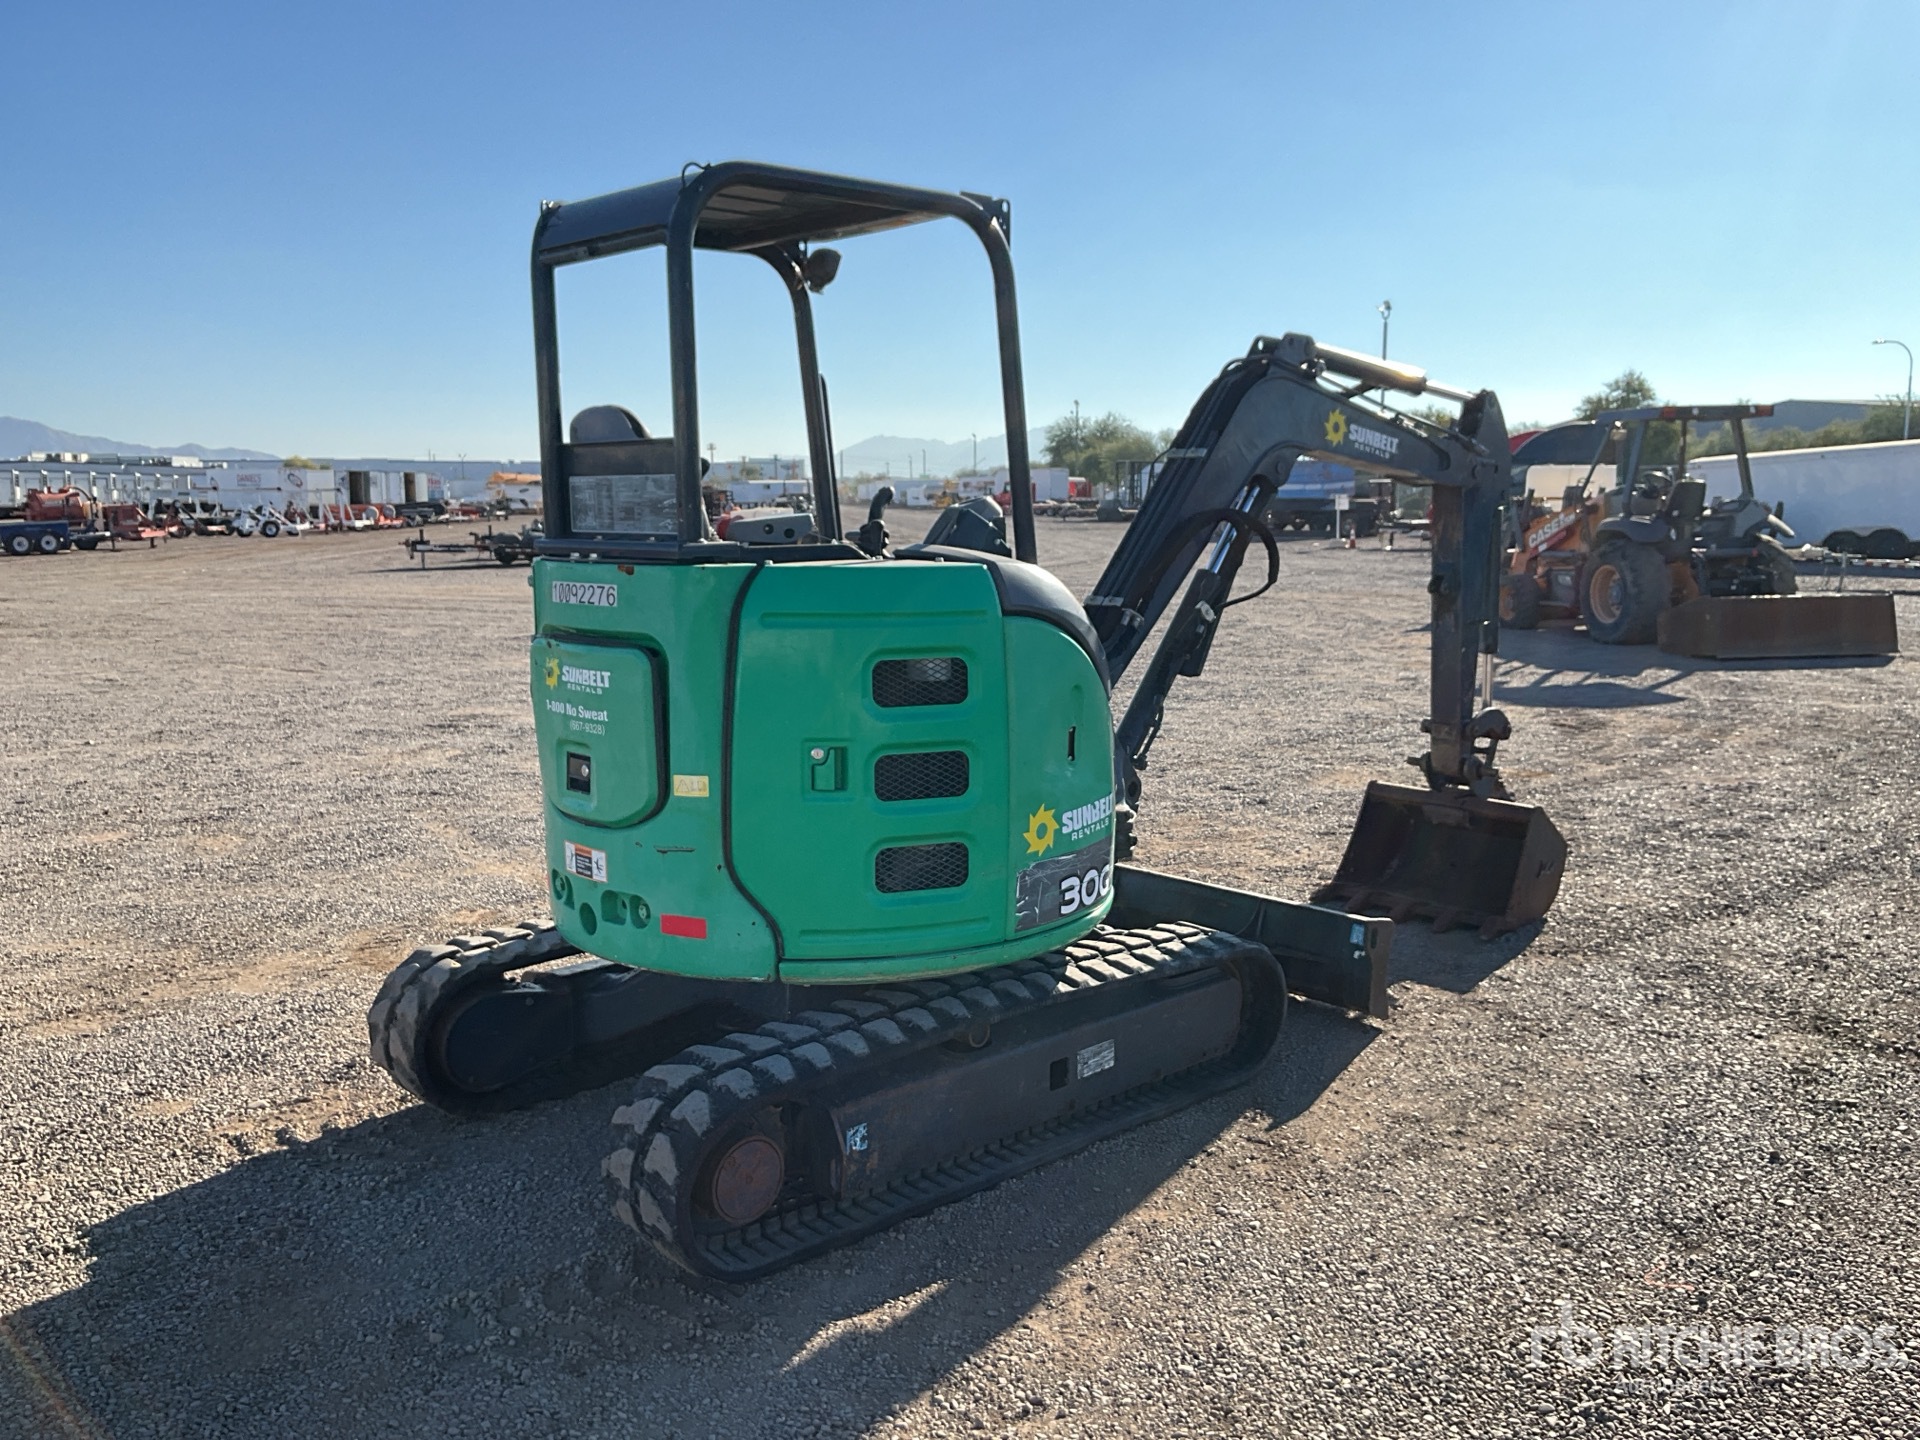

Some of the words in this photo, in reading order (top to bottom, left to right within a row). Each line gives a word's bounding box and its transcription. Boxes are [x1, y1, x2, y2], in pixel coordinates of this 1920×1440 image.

[1348, 423, 1399, 454] SUNBELT
[1354, 442, 1391, 459] RENTALS
[1529, 517, 1560, 549] CASE
[553, 583, 616, 606] 10092276
[561, 665, 611, 688] SUNBELT
[567, 683, 603, 695] RENTALS
[546, 699, 565, 714] 1-800
[566, 702, 577, 716] No
[578, 705, 609, 722] Sweat
[569, 719, 605, 736] (667-9328)
[1071, 817, 1110, 842] RENTALS
